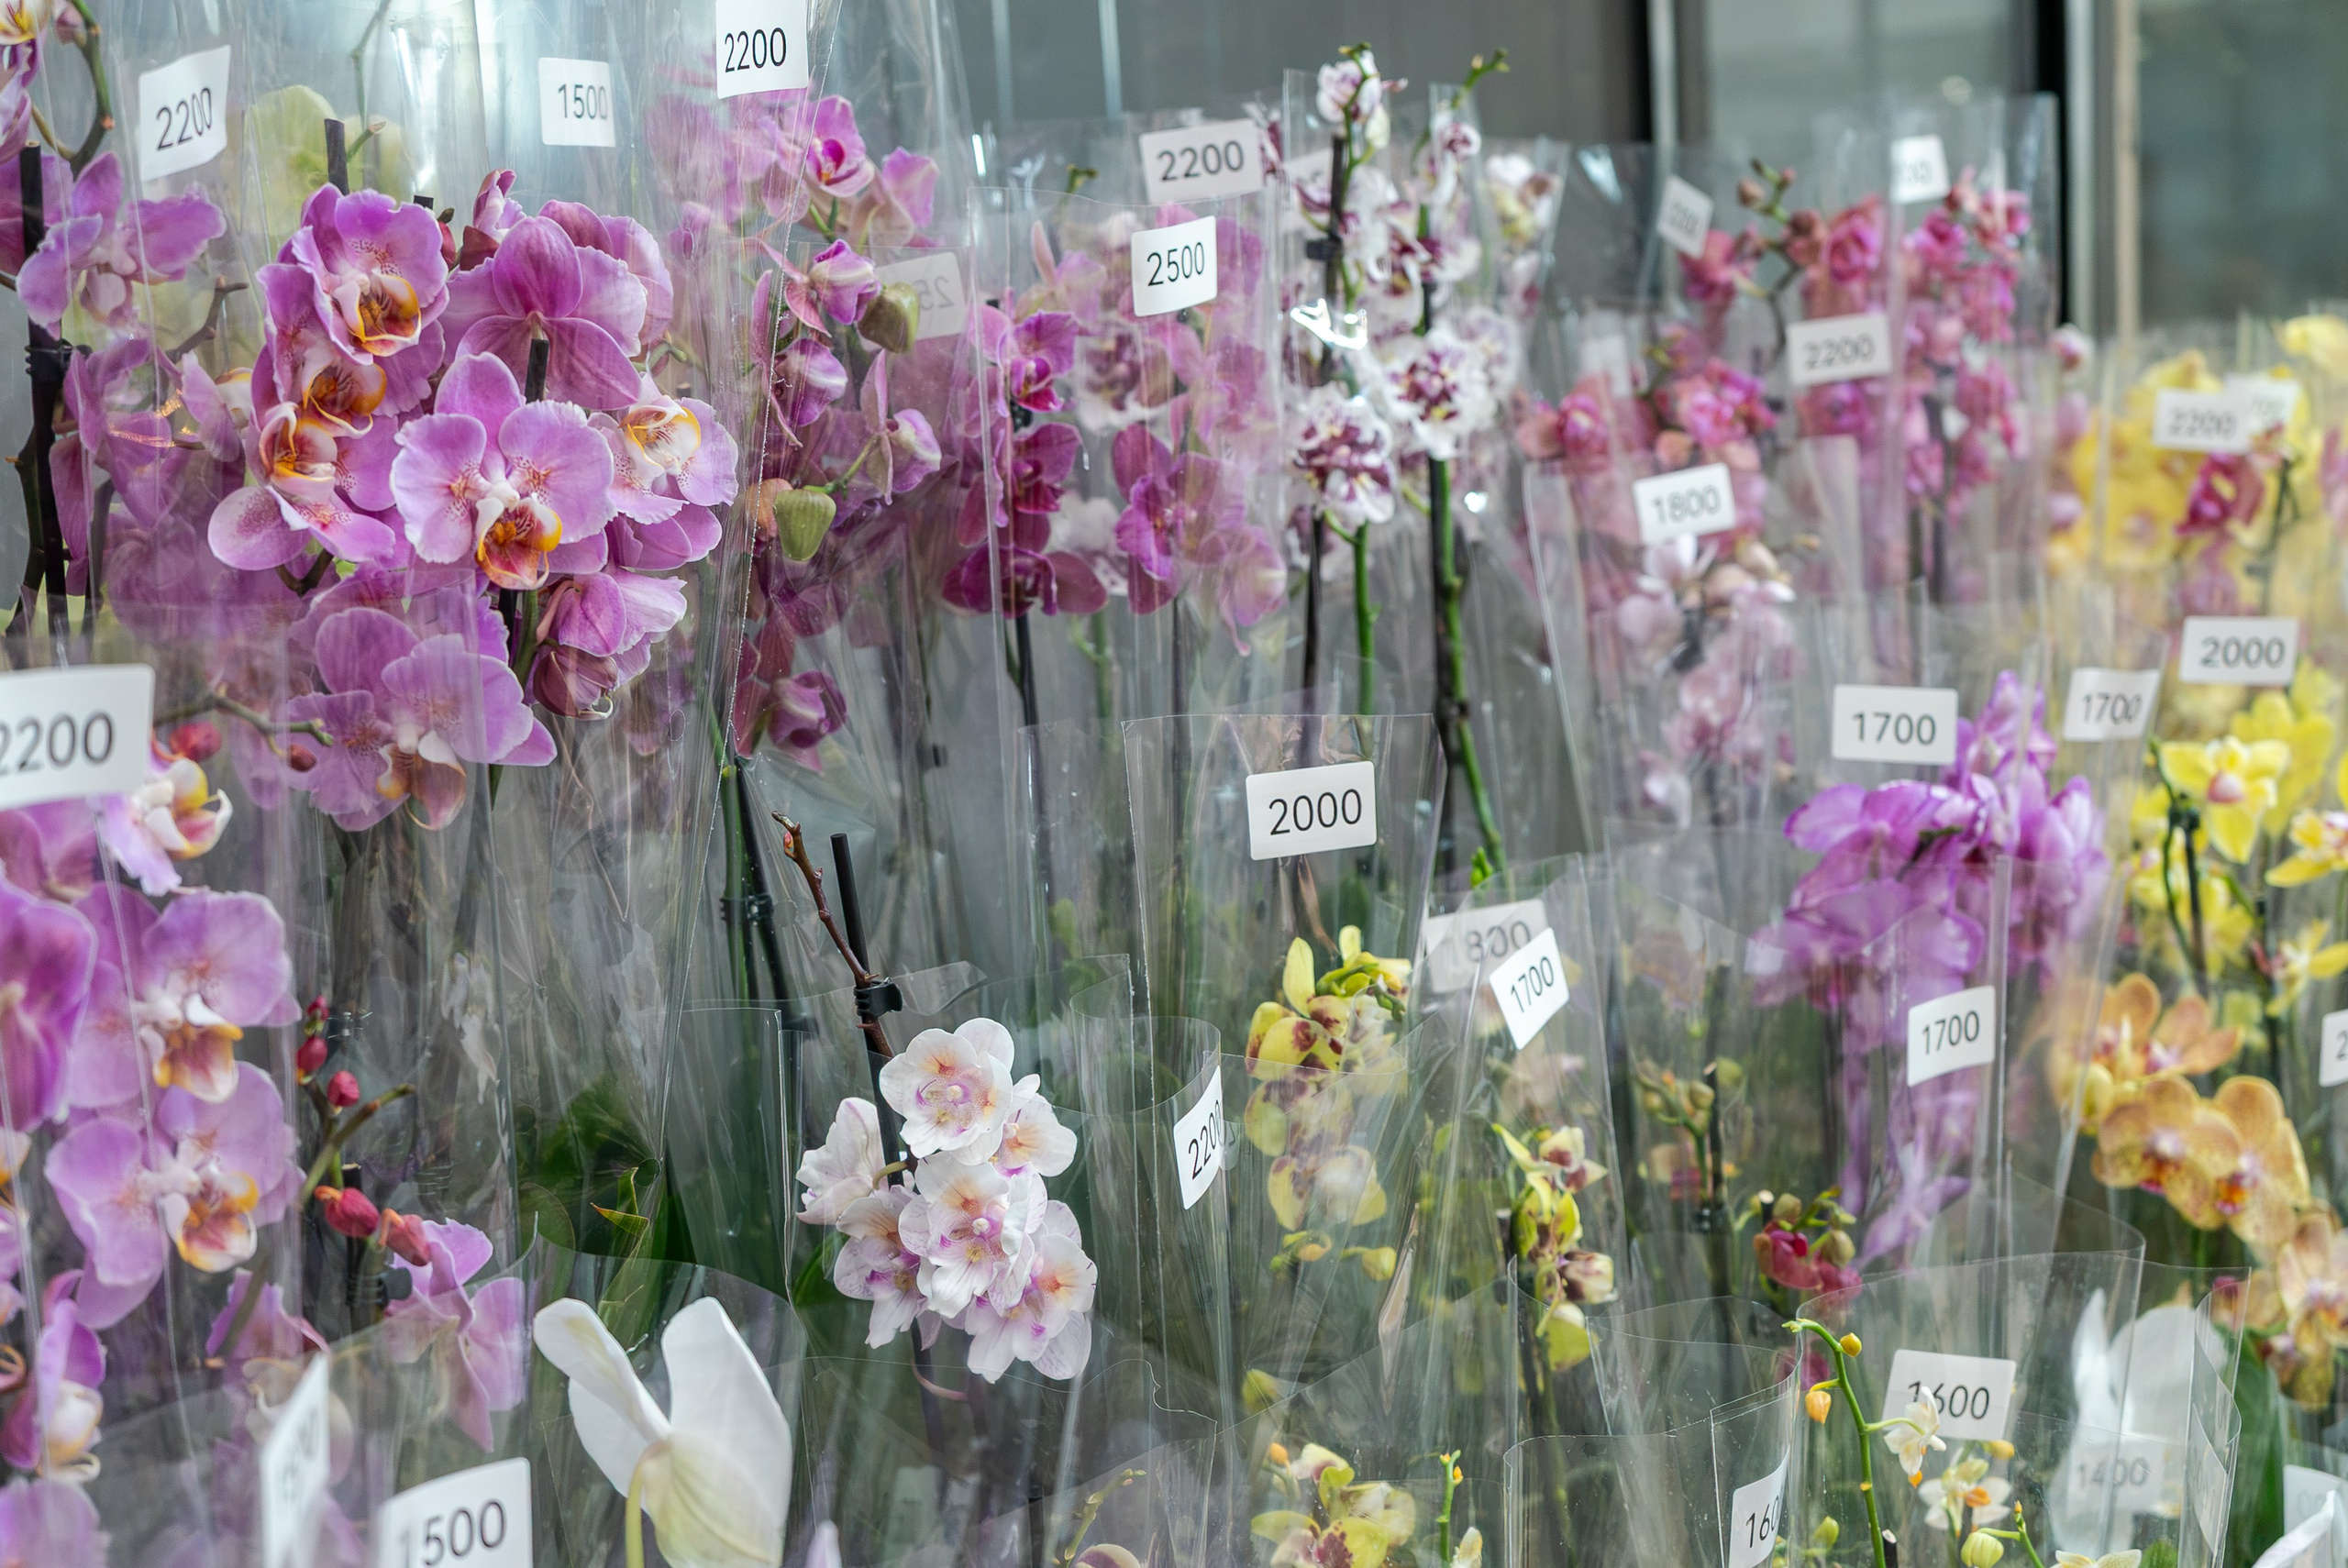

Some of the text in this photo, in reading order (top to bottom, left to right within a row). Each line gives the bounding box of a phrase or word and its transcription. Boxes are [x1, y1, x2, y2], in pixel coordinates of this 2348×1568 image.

[724, 28, 787, 73] 2200
[156, 87, 213, 151] 2200
[558, 83, 608, 120] 1500
[1157, 140, 1245, 182] 2200
[1146, 242, 1205, 287] 2500
[1803, 333, 1875, 370] 2200
[1653, 485, 1720, 524] 1800
[2200, 636, 2285, 668] 2000
[1852, 711, 1937, 745] 1700
[2082, 690, 2142, 723] 1700
[1269, 788, 1363, 835] 2000
[1511, 955, 1555, 1013] 1700
[1922, 1010, 1980, 1055] 1700
[1188, 1099, 1224, 1181] 2200
[1745, 1495, 1780, 1549] 160
